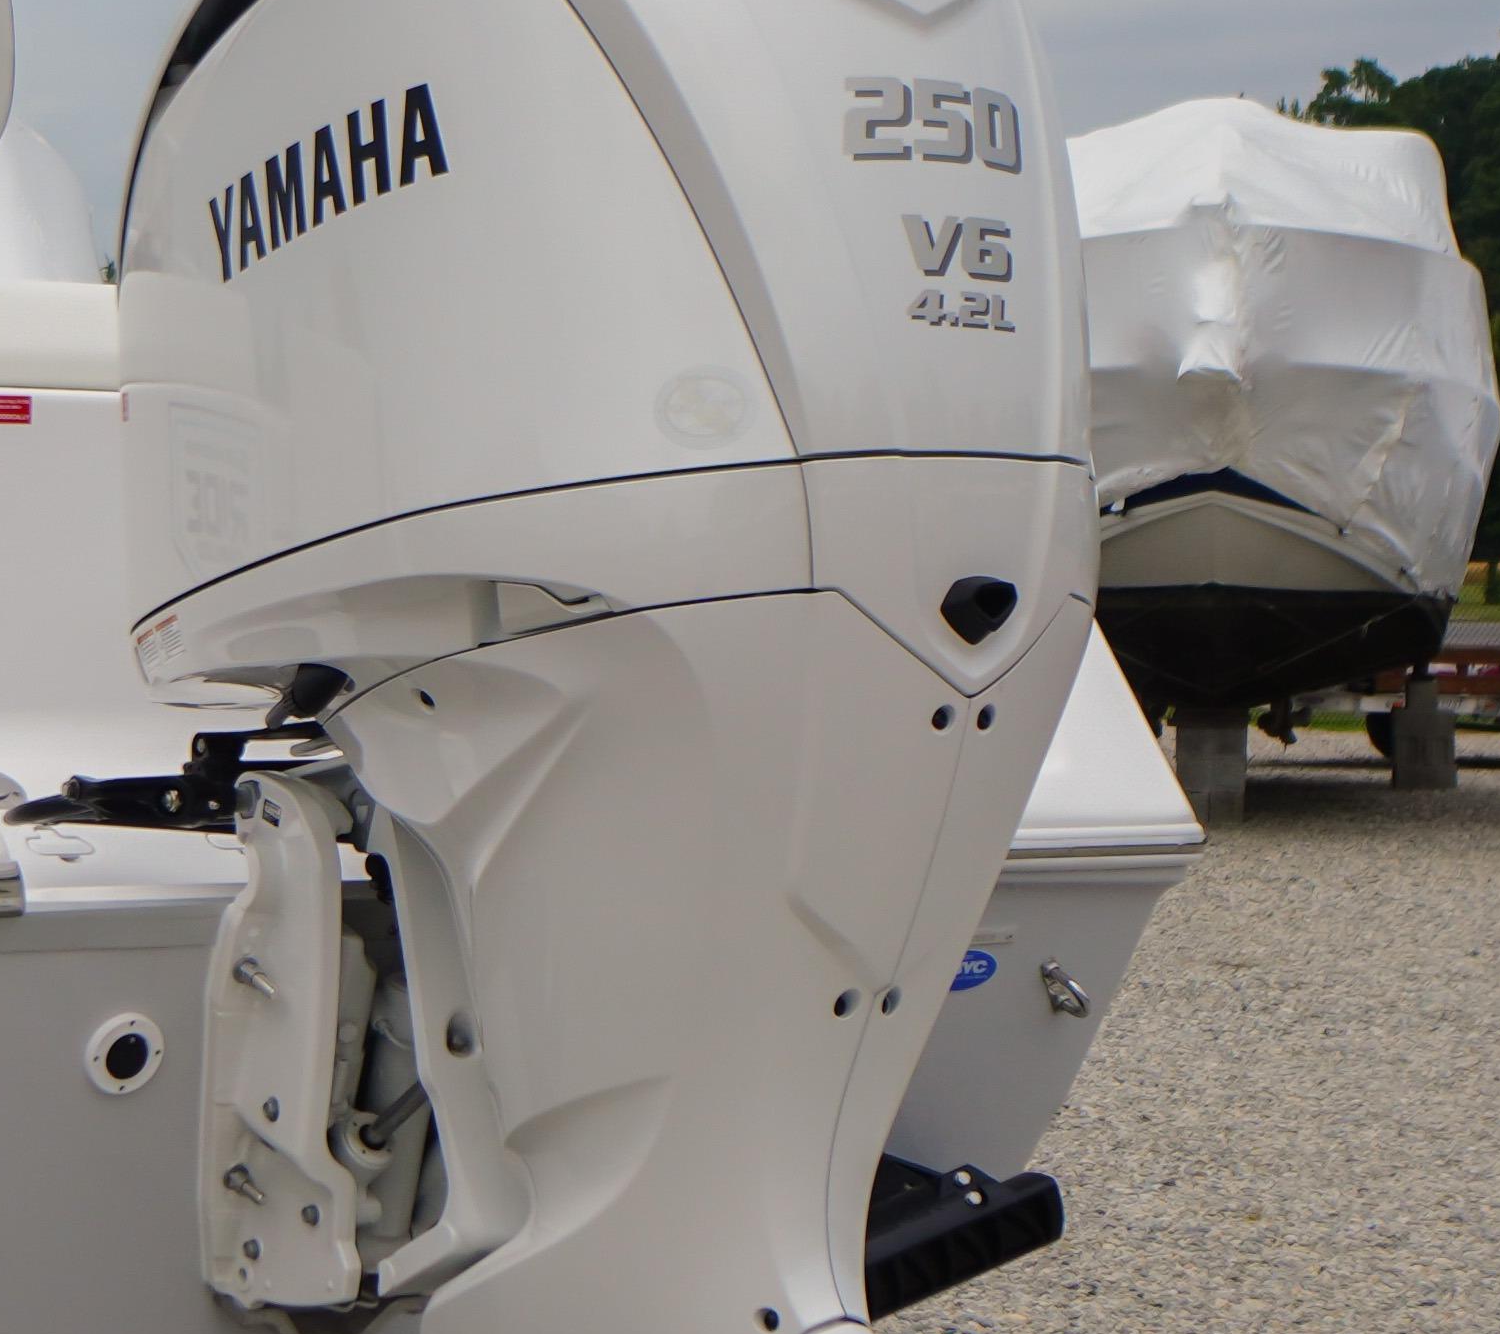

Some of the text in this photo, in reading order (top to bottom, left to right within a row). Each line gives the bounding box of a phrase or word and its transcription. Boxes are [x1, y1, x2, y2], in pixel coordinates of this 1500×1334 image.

[843, 77, 1022, 174] 250
[208, 83, 449, 283] YAMAHA
[901, 214, 1012, 282] V6
[906, 289, 1016, 333] 4.2L
[957, 960, 988, 974] YC
